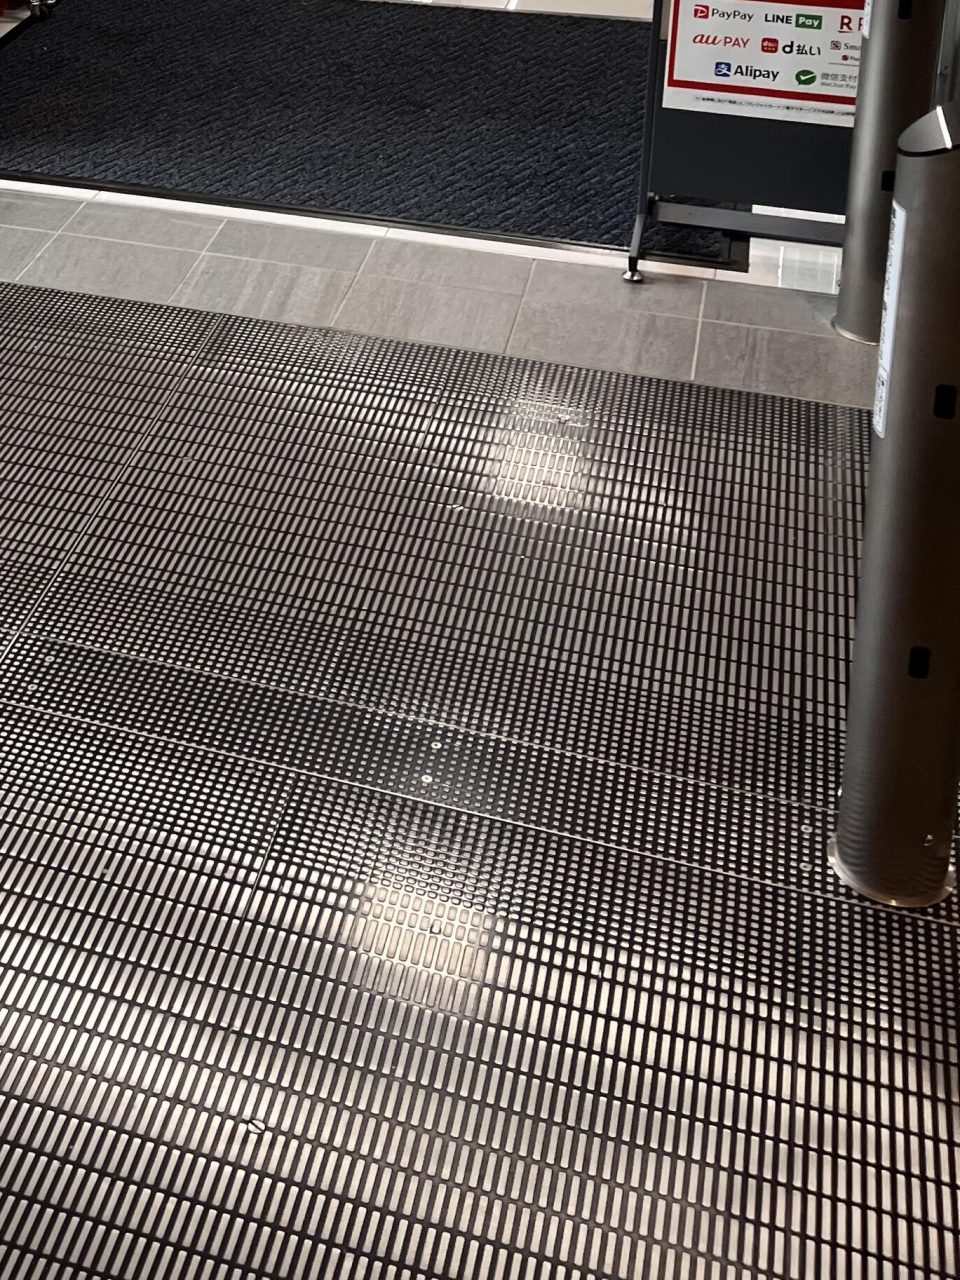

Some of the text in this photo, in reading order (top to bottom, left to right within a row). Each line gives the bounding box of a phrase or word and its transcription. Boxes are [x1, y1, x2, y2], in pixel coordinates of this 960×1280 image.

[711, 7, 754, 23] PayPay
[764, 13, 820, 29] LINE Pay
[692, 33, 724, 46] au
[723, 36, 750, 49] PAY
[733, 65, 780, 81] Alipay
